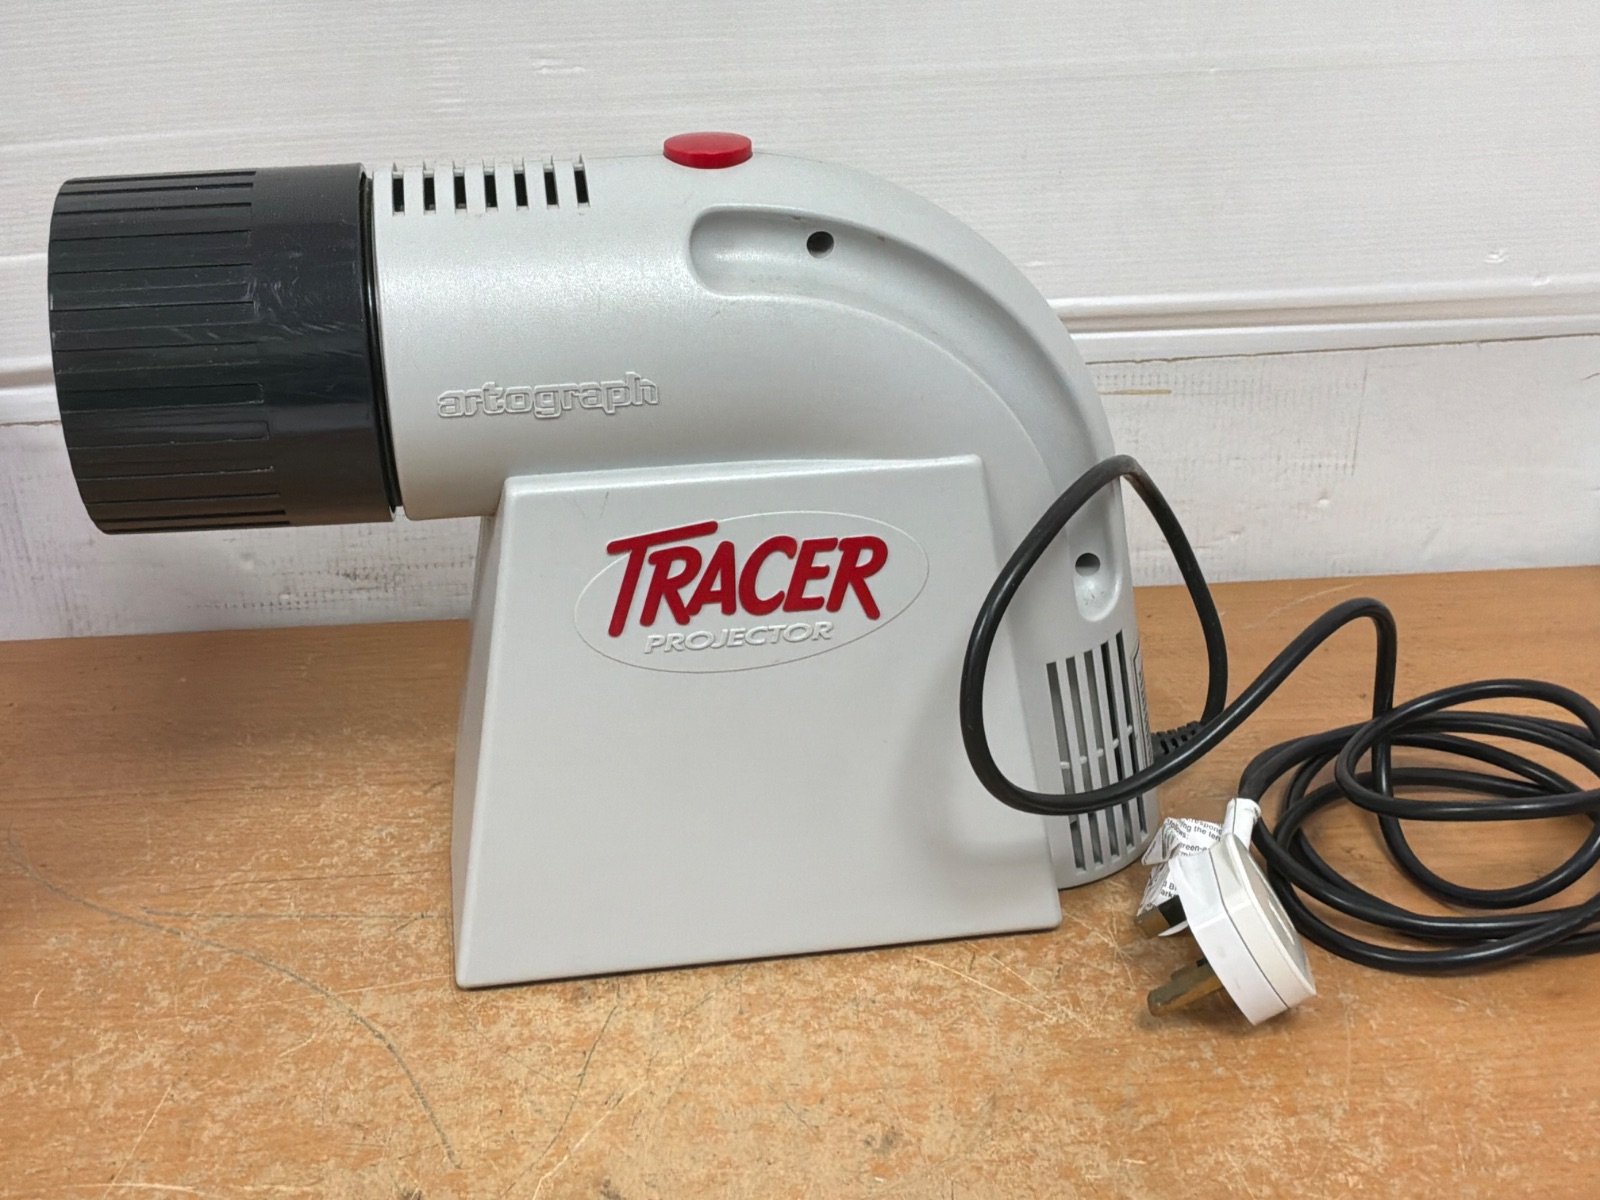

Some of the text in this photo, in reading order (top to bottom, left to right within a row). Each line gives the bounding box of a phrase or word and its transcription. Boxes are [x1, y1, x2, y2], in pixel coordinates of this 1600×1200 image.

[437, 371, 660, 419] artograph
[607, 520, 889, 638] TRACER
[643, 621, 834, 655] PROJECTOR
